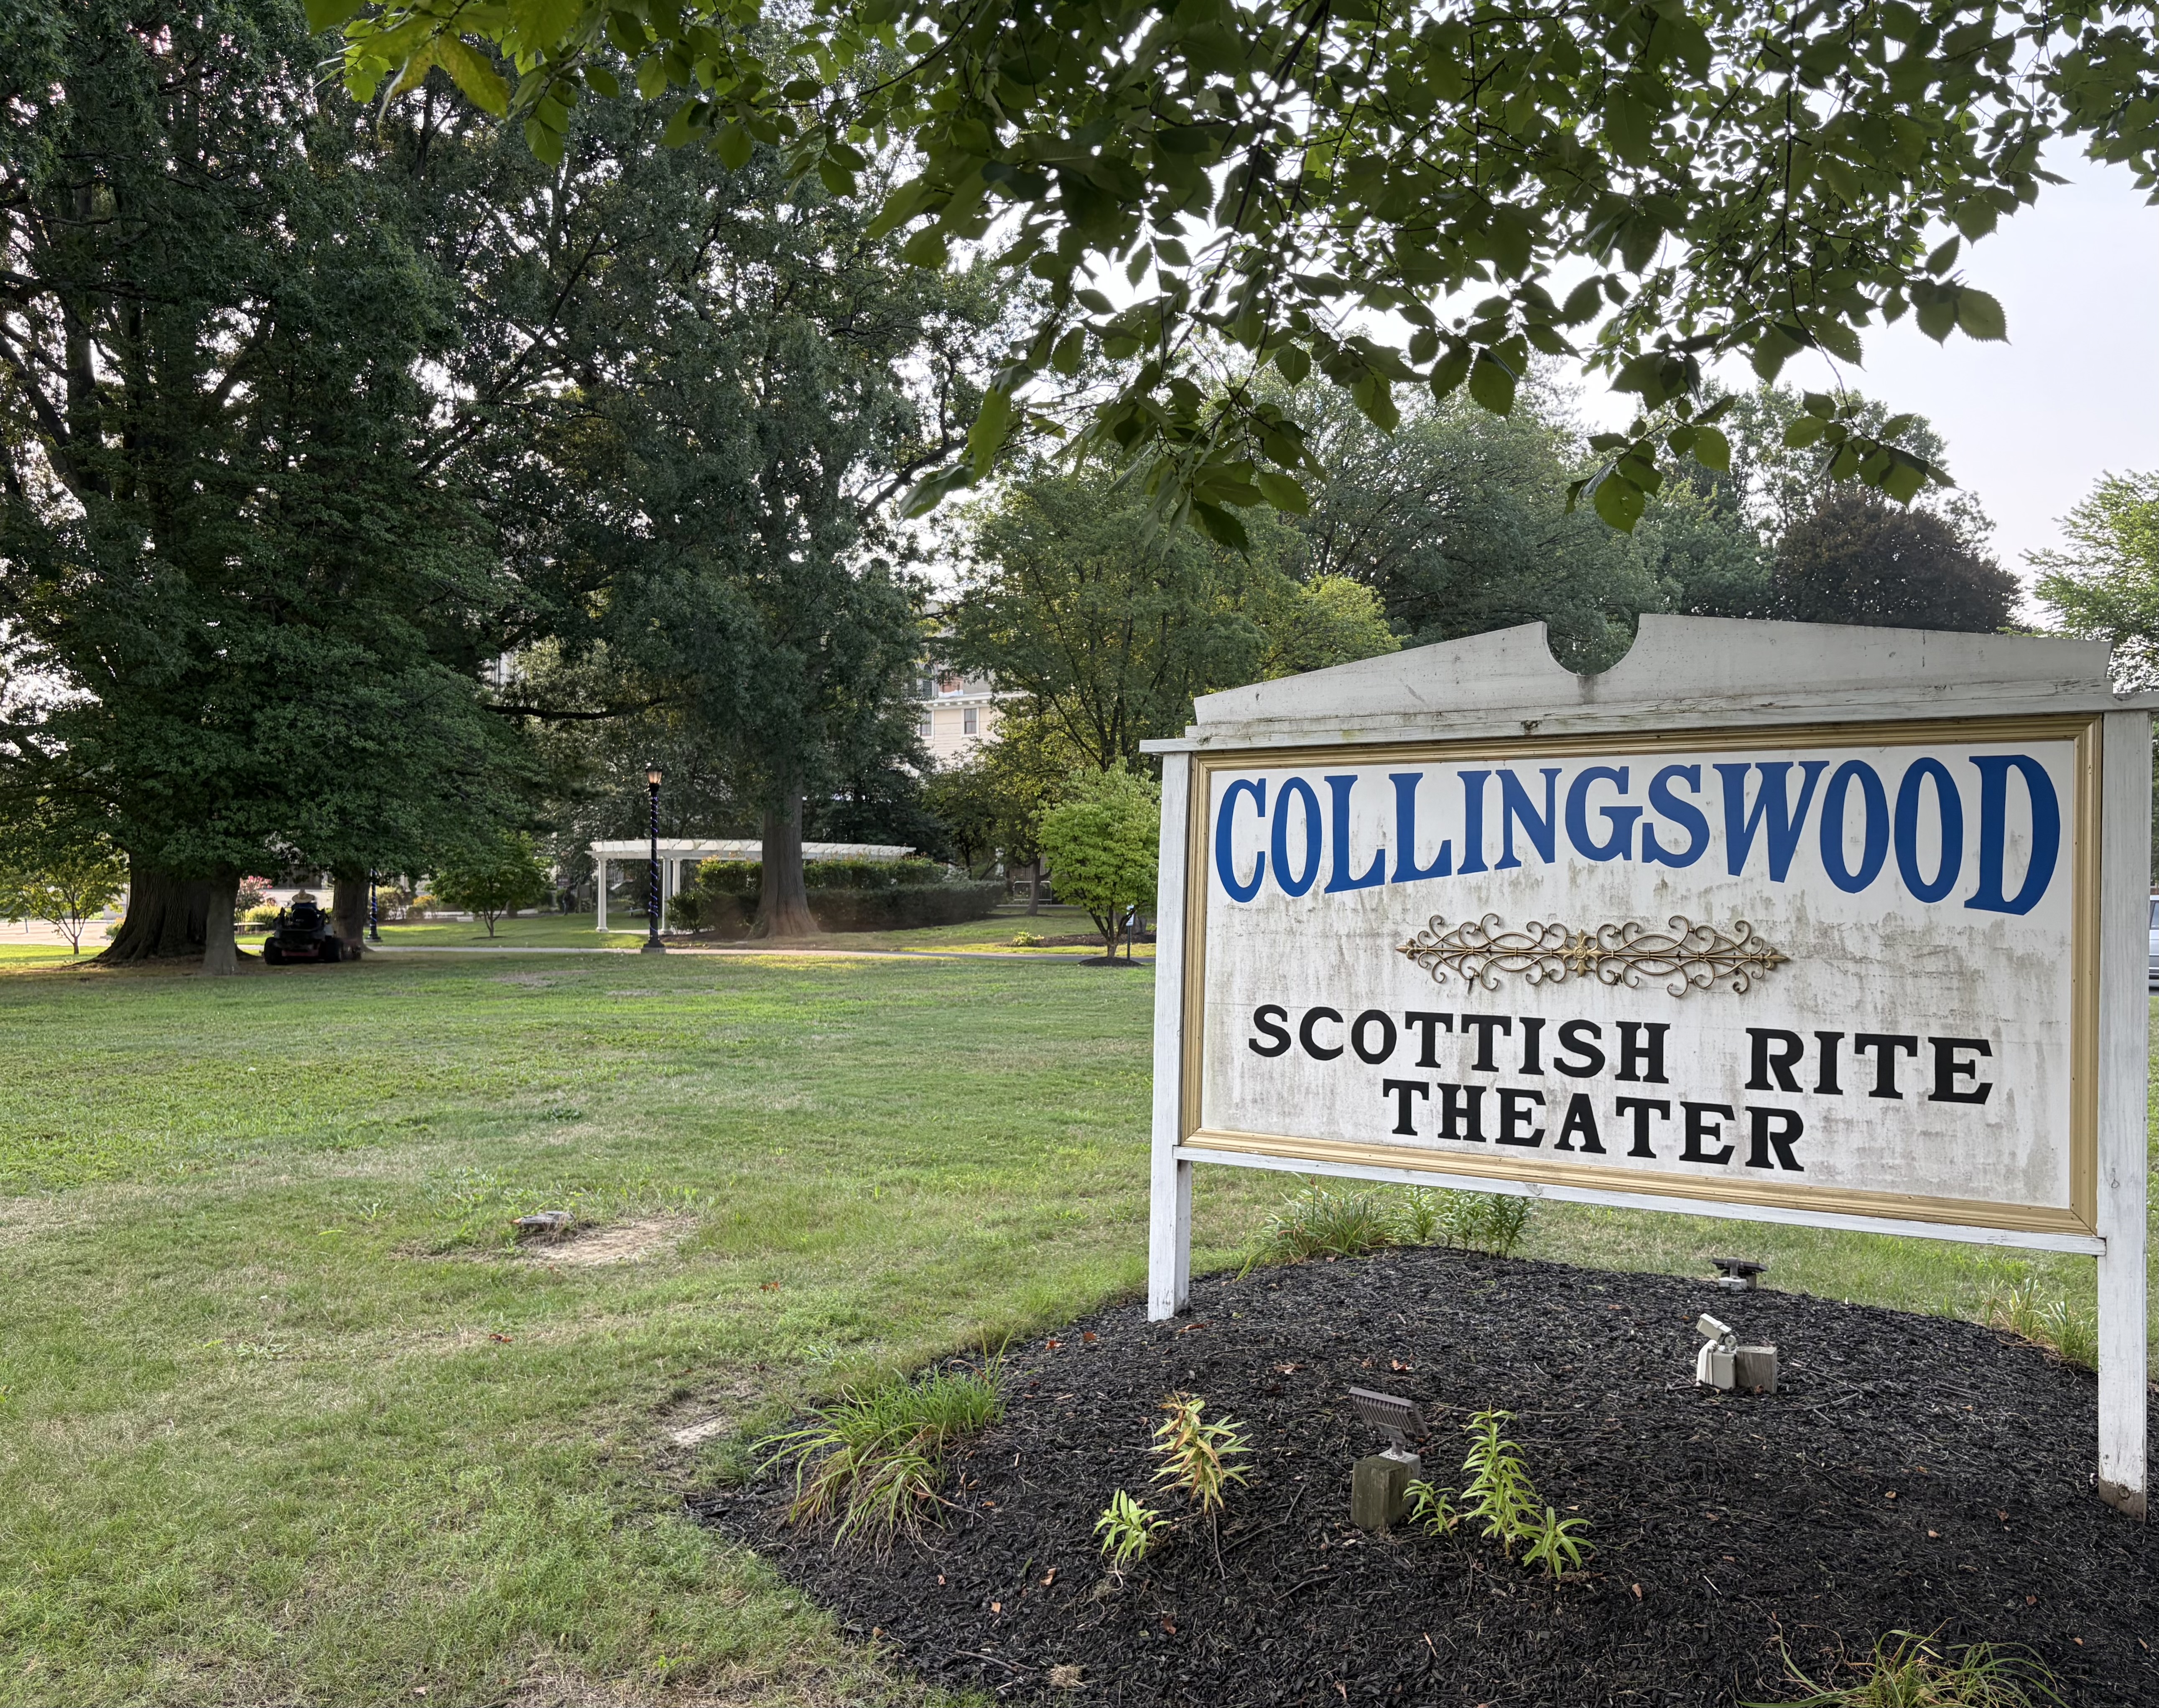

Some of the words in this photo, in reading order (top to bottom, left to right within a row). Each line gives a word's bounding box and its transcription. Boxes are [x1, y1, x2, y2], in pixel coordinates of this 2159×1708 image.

[1215, 754, 2060, 915] COLLINGSWOOD
[1249, 1004, 1670, 1084] SCOTTISH
[1745, 1027, 1993, 1105] RITE
[1383, 1078, 1805, 1172] THEATER
